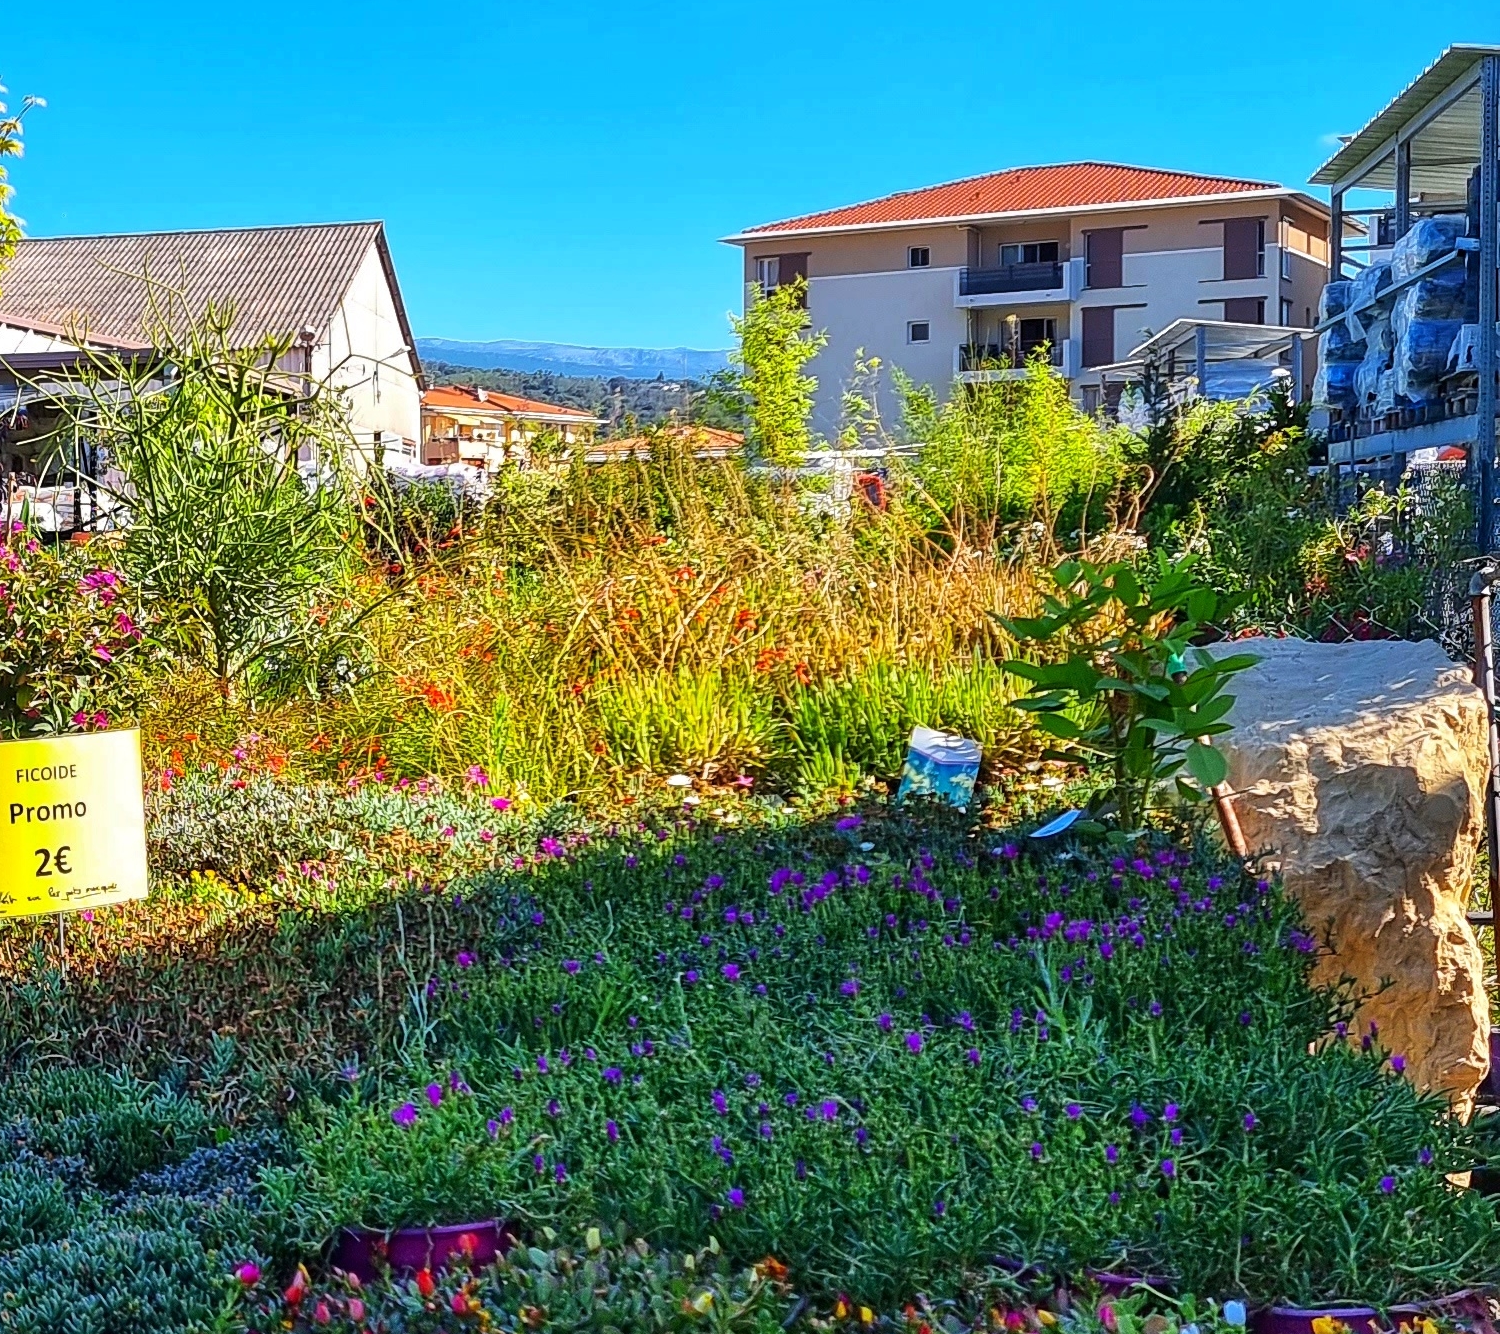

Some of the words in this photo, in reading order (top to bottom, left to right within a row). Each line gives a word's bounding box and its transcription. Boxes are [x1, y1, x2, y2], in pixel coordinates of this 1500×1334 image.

[16, 764, 77, 783] FICOIDE
[10, 801, 87, 824] Promo
[34, 845, 73, 878] 2€
